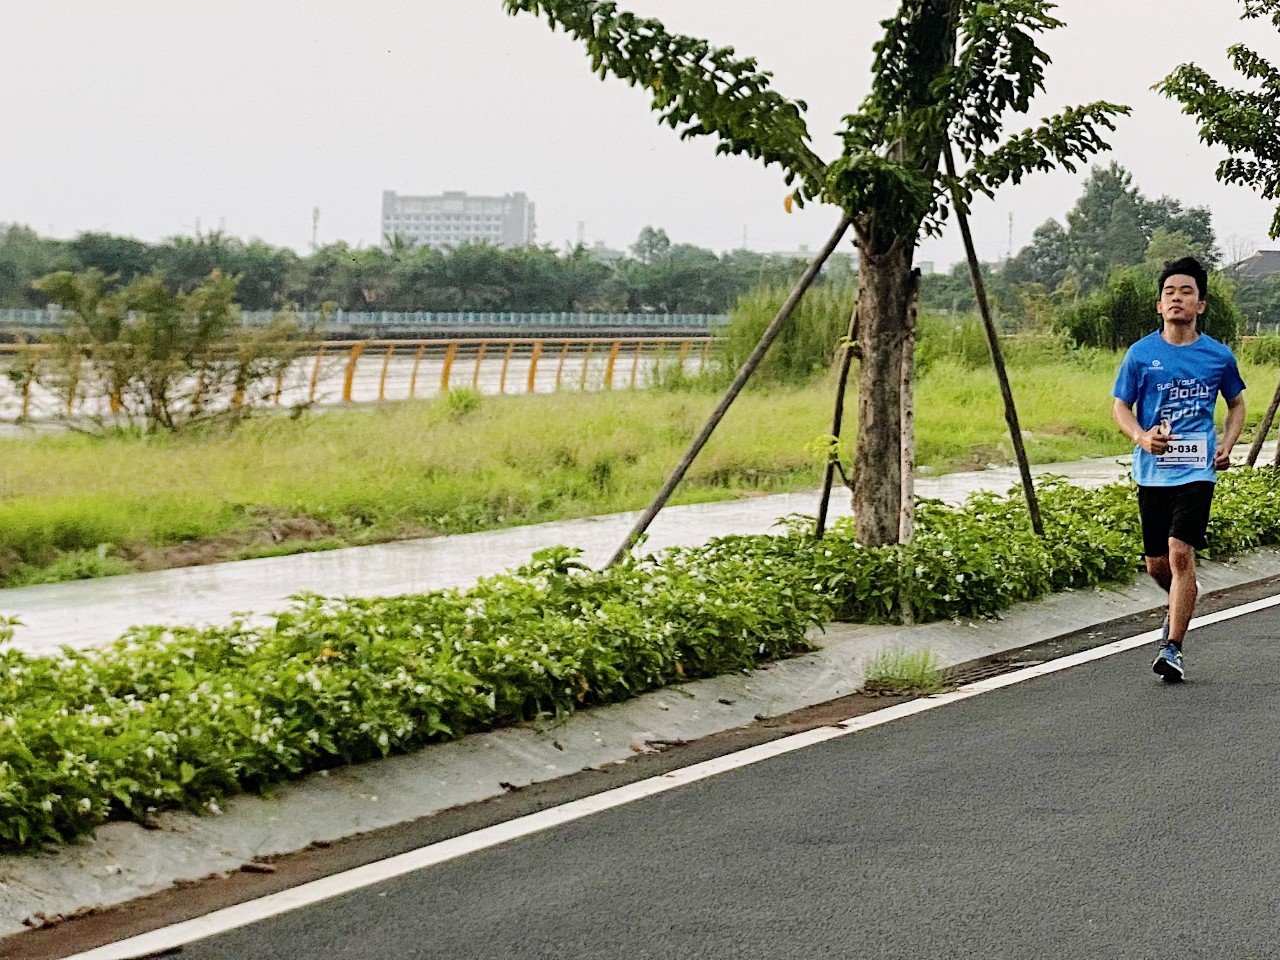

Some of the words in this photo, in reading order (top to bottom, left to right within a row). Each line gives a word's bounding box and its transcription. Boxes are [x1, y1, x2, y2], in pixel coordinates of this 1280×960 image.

[1157, 382, 1174, 391] Fuel
[1177, 378, 1197, 386] Your
[1169, 383, 1209, 400] Body
[1167, 445, 1197, 453] O-038
